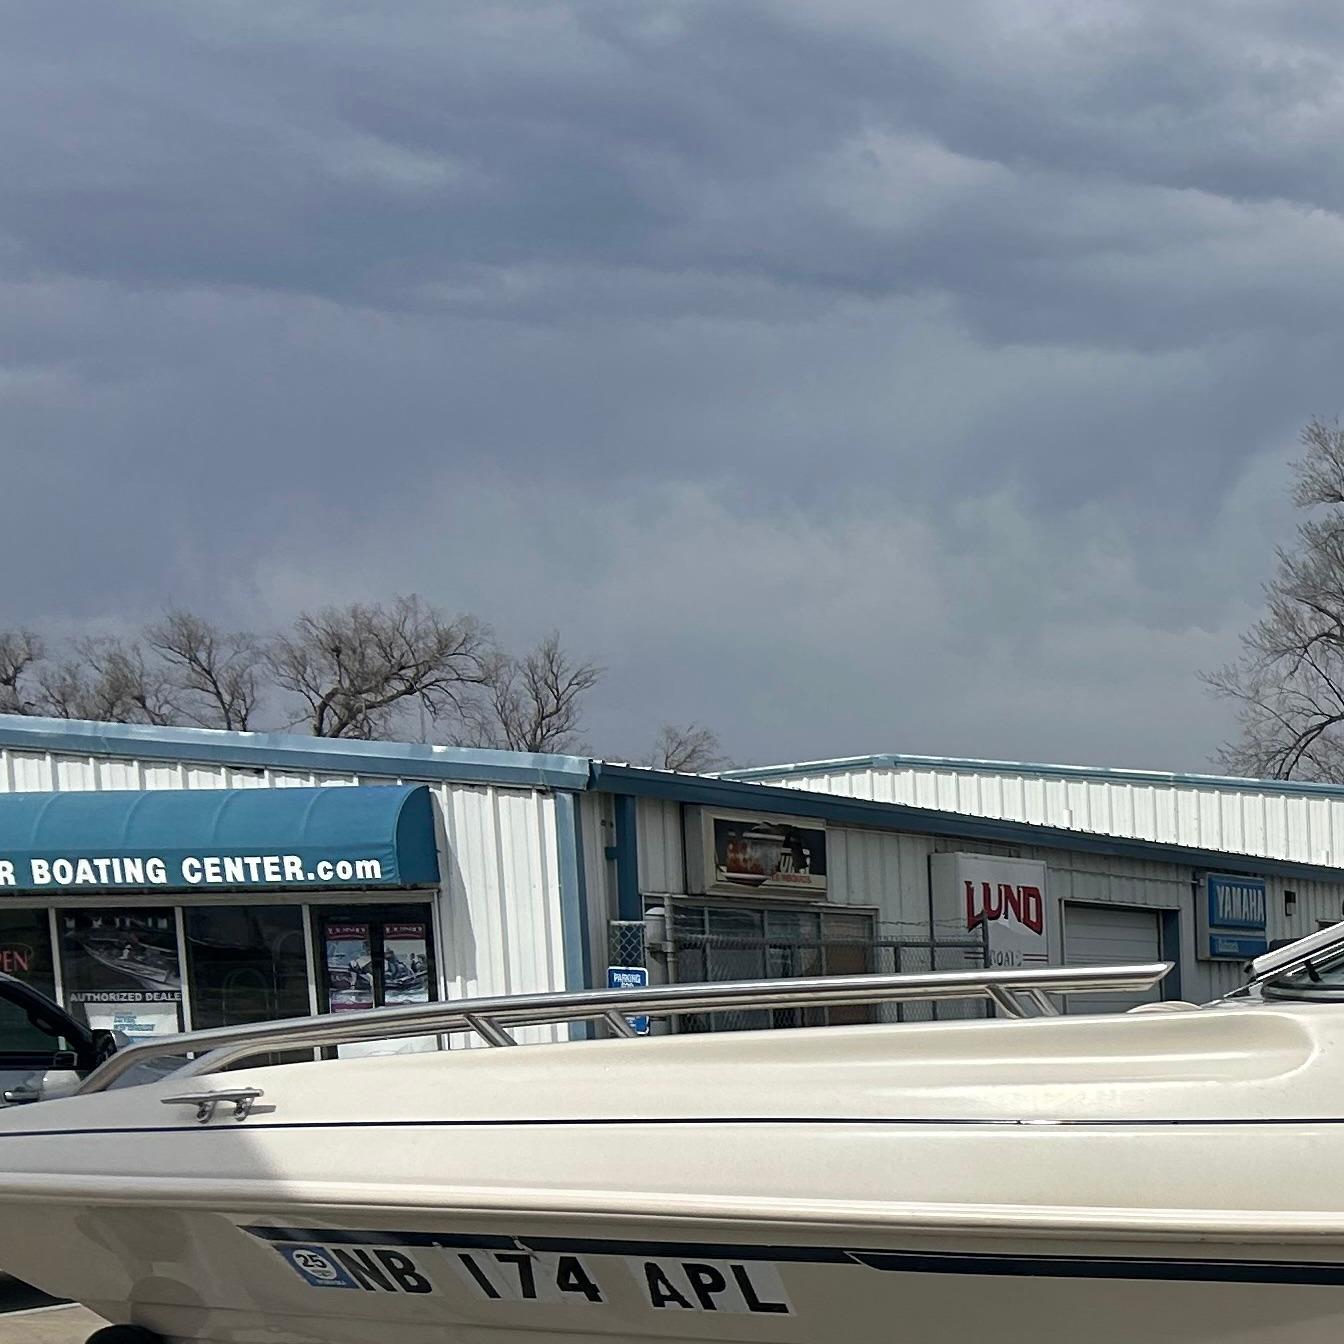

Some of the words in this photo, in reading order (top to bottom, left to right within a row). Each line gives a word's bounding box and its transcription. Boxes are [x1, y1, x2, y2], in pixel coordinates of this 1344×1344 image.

[30, 857, 168, 885] BOATING
[181, 855, 382, 884] CENTER.com
[964, 880, 1044, 936] LUND
[1216, 885, 1265, 922] YAMAHA
[613, 972, 641, 984] PARKING
[70, 992, 143, 1002] AUTHORIZED
[295, 1254, 328, 1269] 25
[330, 1248, 433, 1293] NB
[459, 1252, 605, 1303] 174
[641, 1260, 790, 1314] APL
